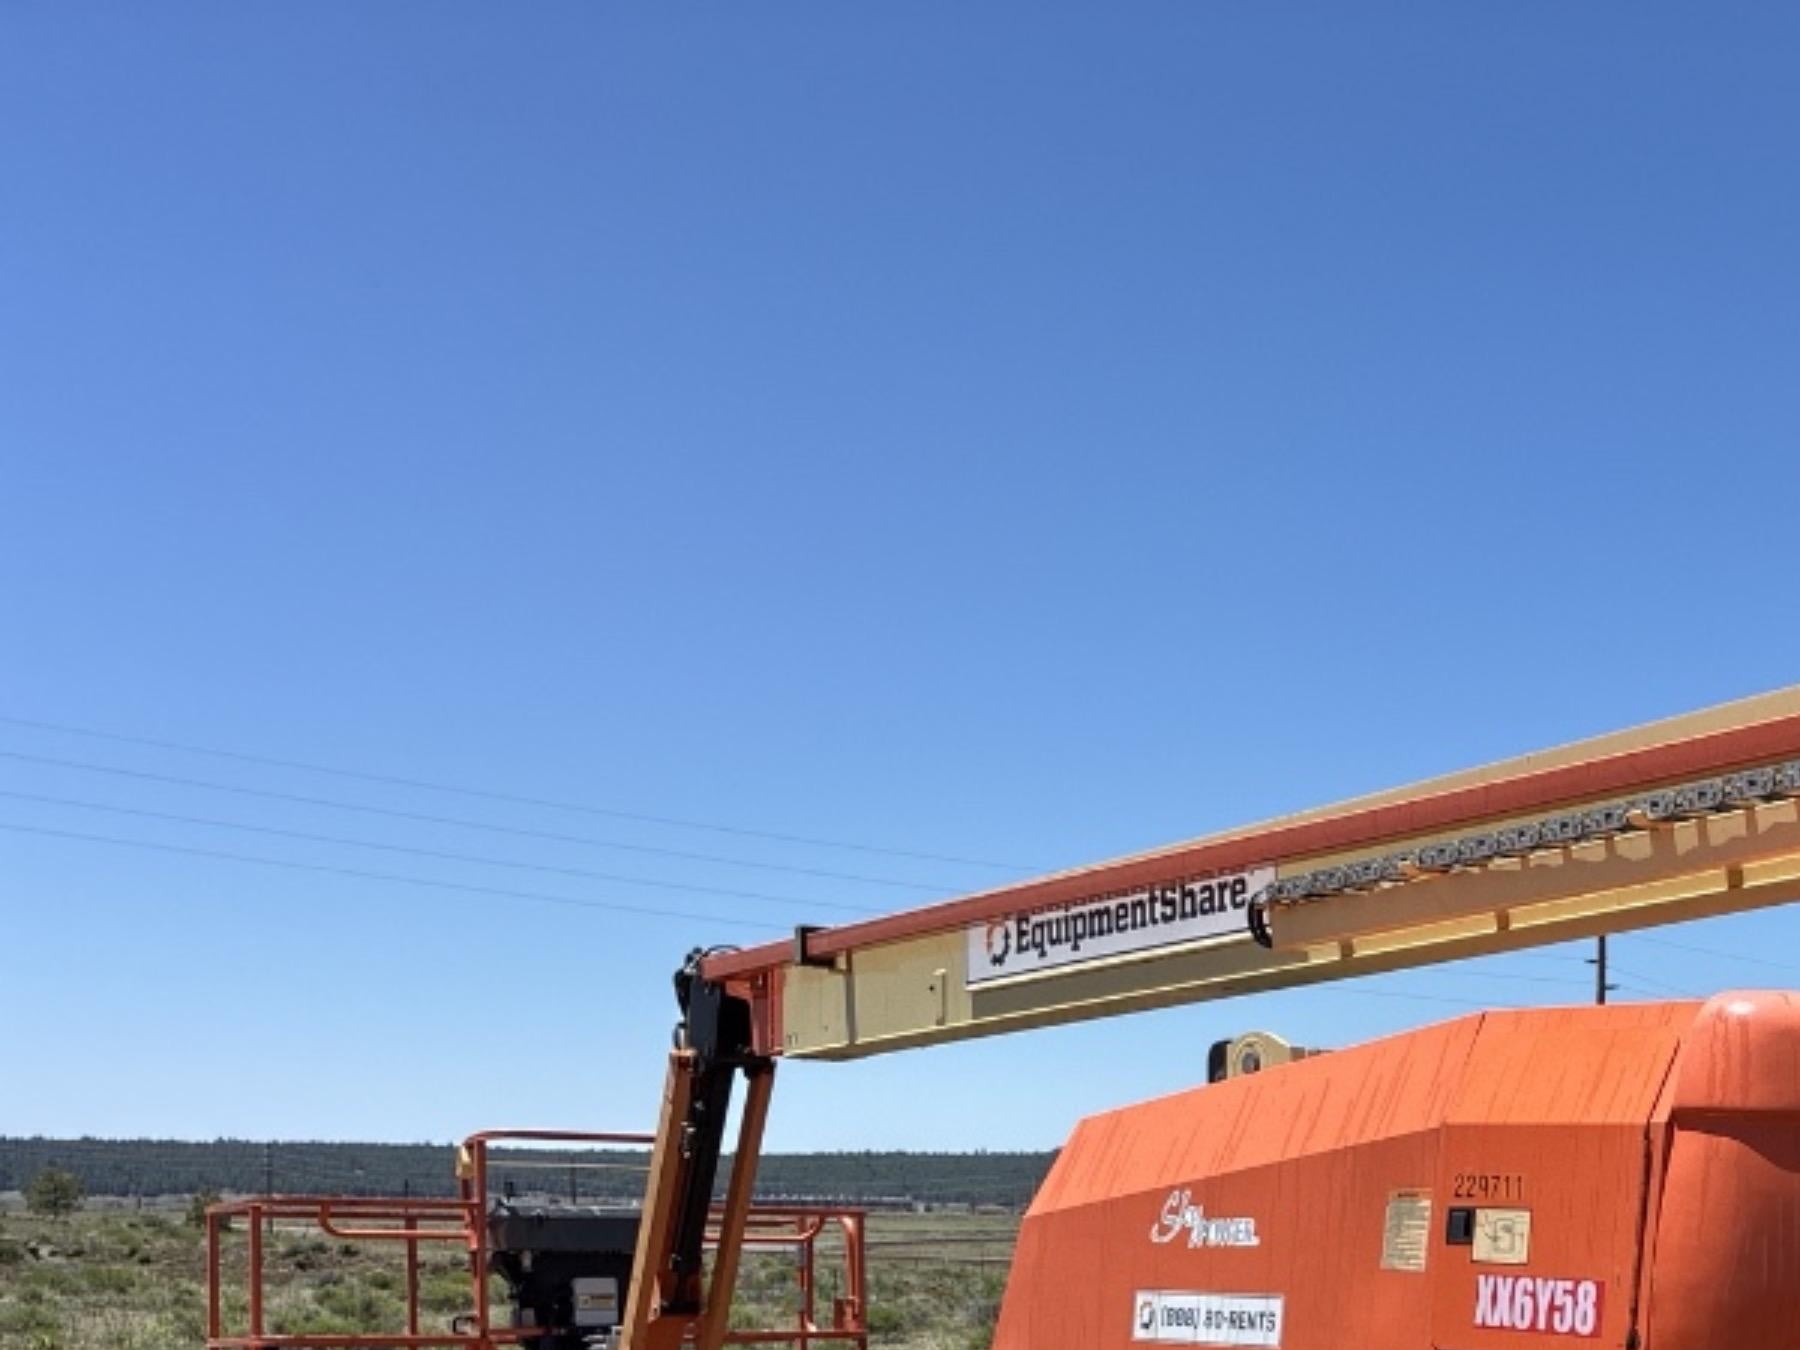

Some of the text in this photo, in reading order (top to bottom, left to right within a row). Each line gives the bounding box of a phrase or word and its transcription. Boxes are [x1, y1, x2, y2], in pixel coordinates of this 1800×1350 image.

[1015, 876, 1247, 958] EquipmentShare
[1454, 1175, 1523, 1200] 229711
[1474, 1273, 1598, 1337] XX6Y58
